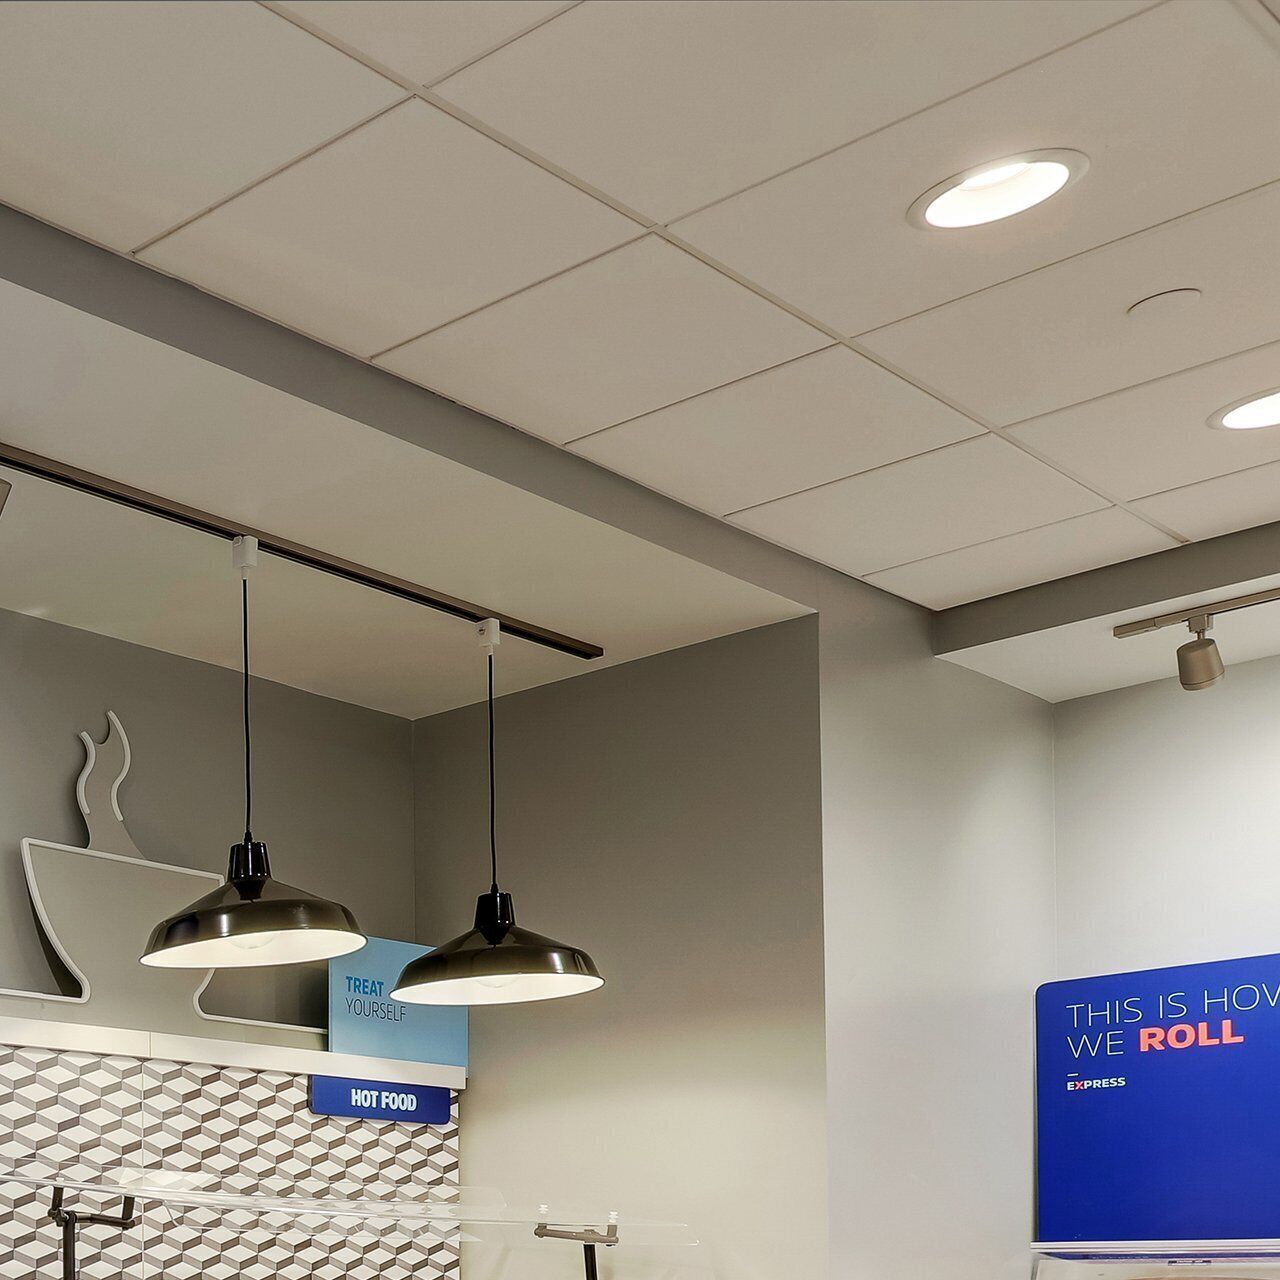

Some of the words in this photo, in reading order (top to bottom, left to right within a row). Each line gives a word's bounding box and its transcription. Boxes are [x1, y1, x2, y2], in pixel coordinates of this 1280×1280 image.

[345, 975, 385, 997] TREAT
[345, 997, 407, 1022] YOURSELF
[1066, 997, 1144, 1028] THIS
[1159, 992, 1188, 1019] IS
[1067, 1030, 1124, 1059] WE
[1139, 1019, 1245, 1053] ROLL
[1066, 1077, 1126, 1091] EXPRESS
[351, 1088, 378, 1109] HOT
[381, 1090, 417, 1111] FOOD
